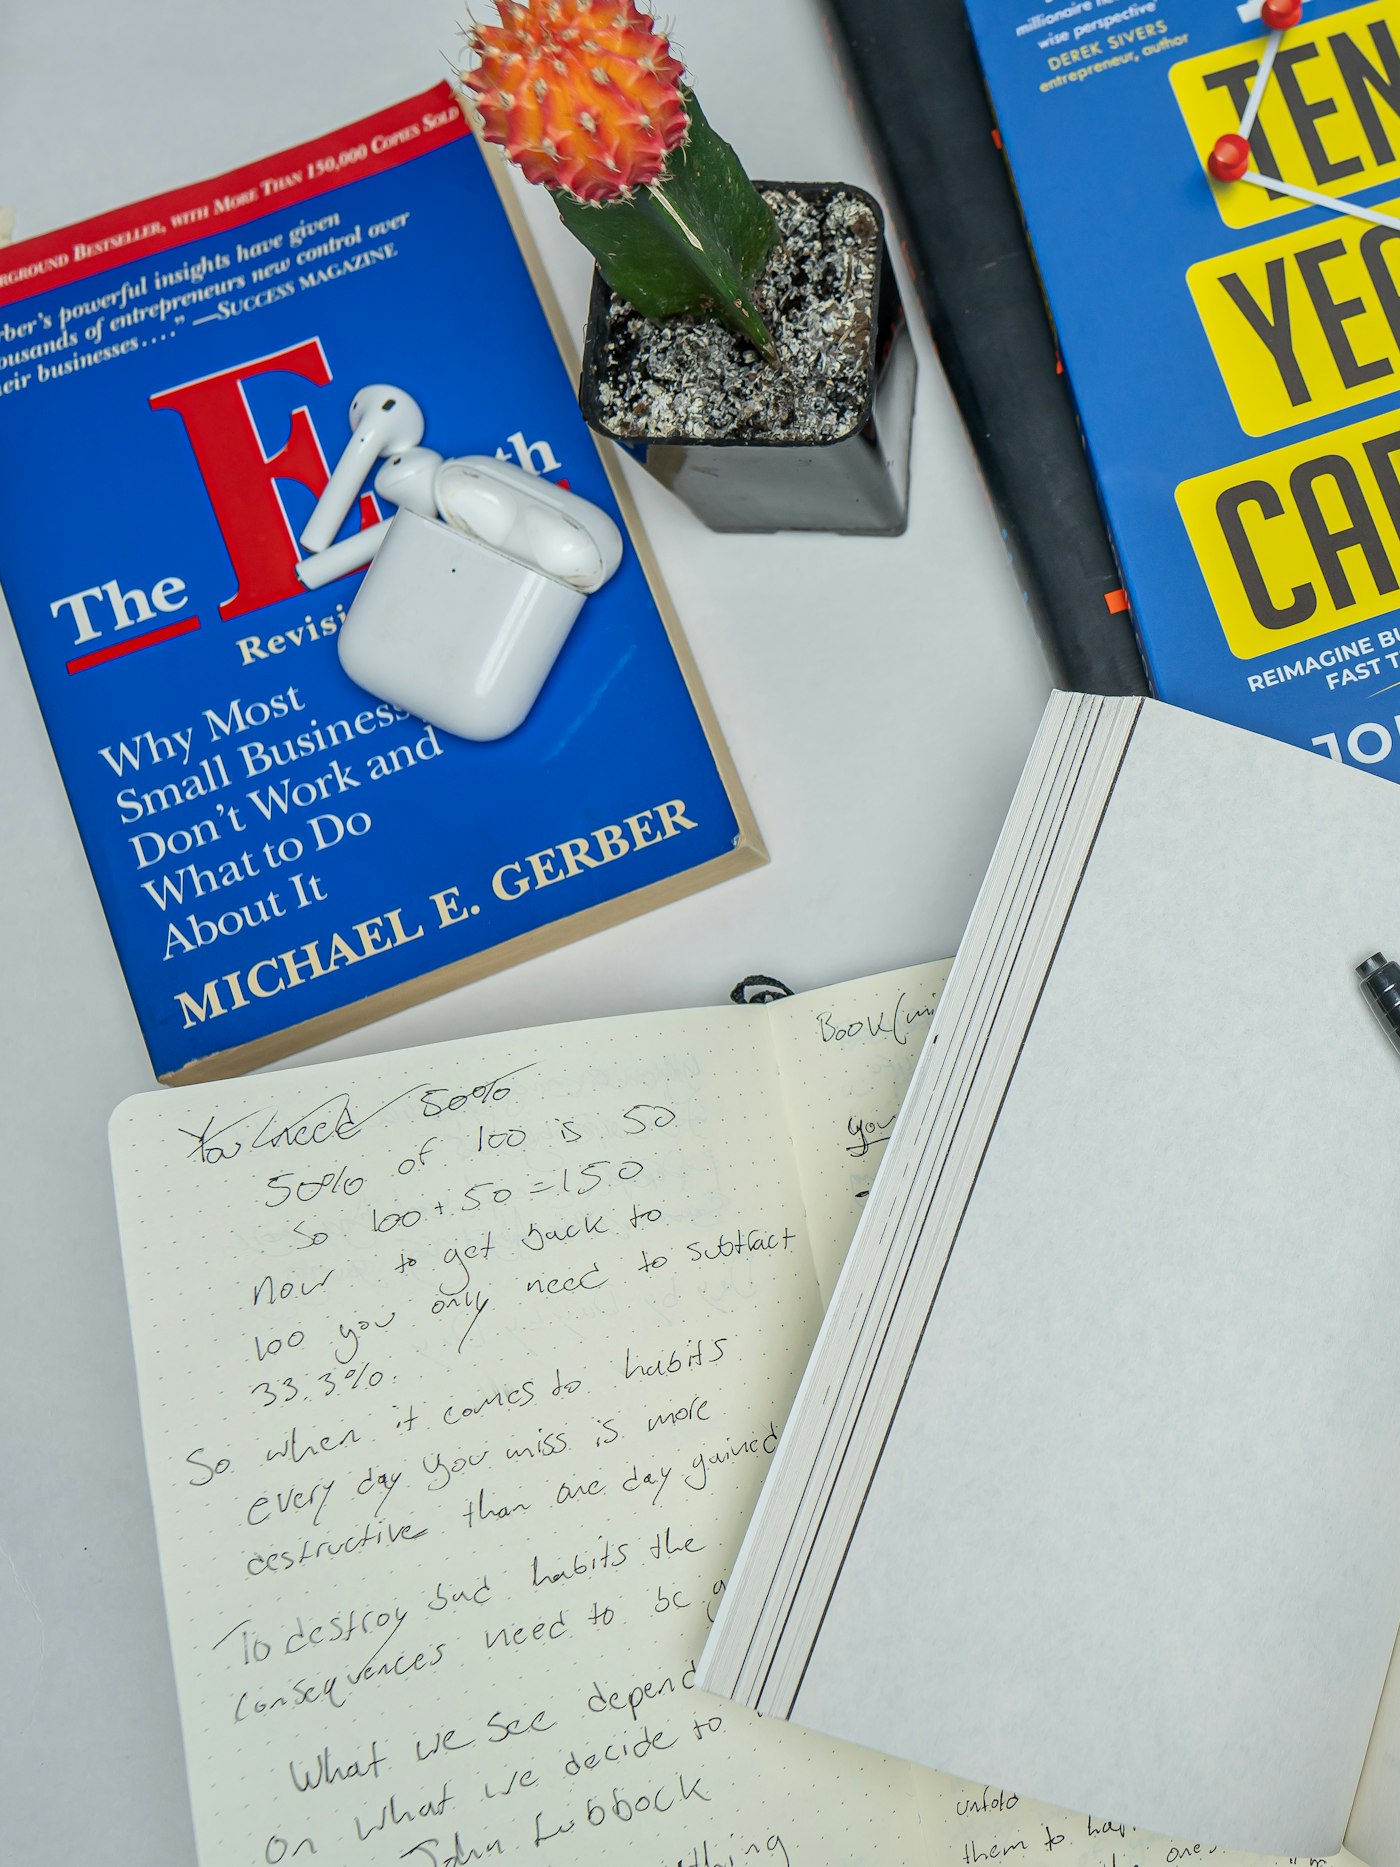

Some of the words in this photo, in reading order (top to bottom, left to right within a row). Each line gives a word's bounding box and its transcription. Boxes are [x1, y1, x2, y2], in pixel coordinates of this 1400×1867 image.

[1016, 0, 1093, 37] millionaire
[1037, 30, 1070, 49] wise
[1073, 1, 1157, 40] perspective
[1047, 41, 1103, 71] DEREK
[1106, 19, 1168, 50] SIVERS
[1039, 51, 1140, 93] entrepreneur,
[1141, 33, 1189, 57] author
[0, 253, 70, 288] RGROUND
[0, 312, 52, 342] ber's
[59, 276, 148, 329] powerful
[154, 253, 231, 291] insights
[236, 234, 283, 263] have
[288, 212, 340, 248] given
[0, 330, 79, 370] ousands
[84, 316, 105, 345] of
[109, 275, 246, 332] entrepreneurs
[251, 257, 291, 284] new
[295, 224, 362, 266] control
[367, 212, 410, 238] over
[50, 576, 188, 645] The
[235, 603, 347, 666] Revisi
[1247, 636, 1375, 693] REIMAGINE
[1325, 657, 1381, 691] FAST
[98, 727, 193, 777] Why
[202, 686, 306, 742] Most
[116, 754, 232, 824] Small
[237, 705, 411, 778] Business
[128, 803, 247, 870] Don't
[246, 760, 361, 821] Work
[366, 725, 444, 781] and
[142, 851, 260, 911] What
[262, 838, 304, 868] to
[306, 812, 372, 852] Do
[163, 891, 287, 961] About
[288, 872, 328, 909] It
[173, 908, 425, 1030] MICHAEL
[428, 886, 481, 929] E.
[491, 799, 699, 901] GERBER
[264, 1170, 364, 1209] 50%
[397, 1138, 438, 1179] of
[477, 1126, 528, 1153] 100
[623, 1104, 677, 1136] 50
[186, 1447, 231, 1486] So
[649, 1532, 706, 1562] the
[484, 1612, 569, 1650] need
[589, 1602, 615, 1627] to
[289, 1749, 388, 1793] What
[416, 1728, 476, 1763] we
[565, 1727, 679, 1776] decide
[694, 1715, 723, 1742] to
[1045, 1826, 1066, 1852] to
